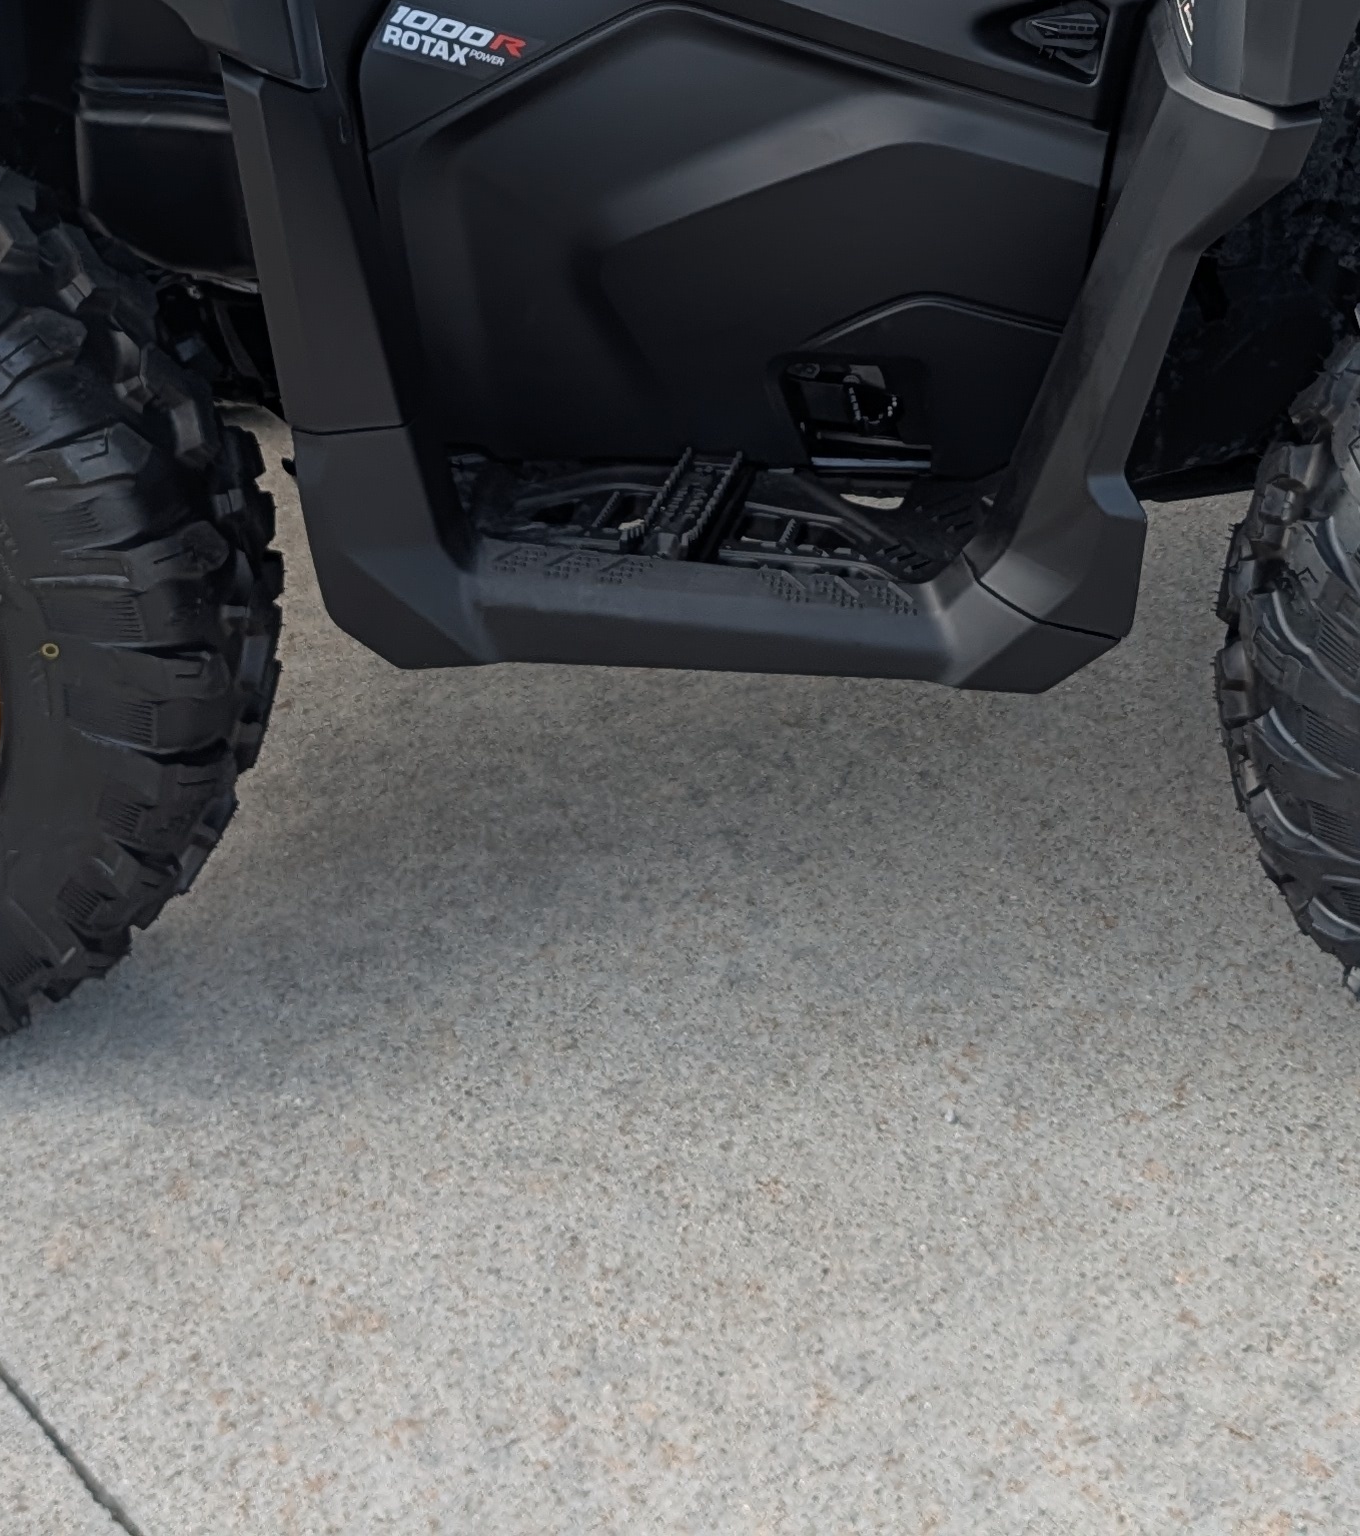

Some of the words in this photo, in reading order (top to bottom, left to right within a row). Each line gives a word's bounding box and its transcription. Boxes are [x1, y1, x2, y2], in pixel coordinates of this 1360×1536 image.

[382, 24, 471, 67] ROTAX
[468, 48, 506, 67] POWER
[389, 5, 527, 59] 1000R
